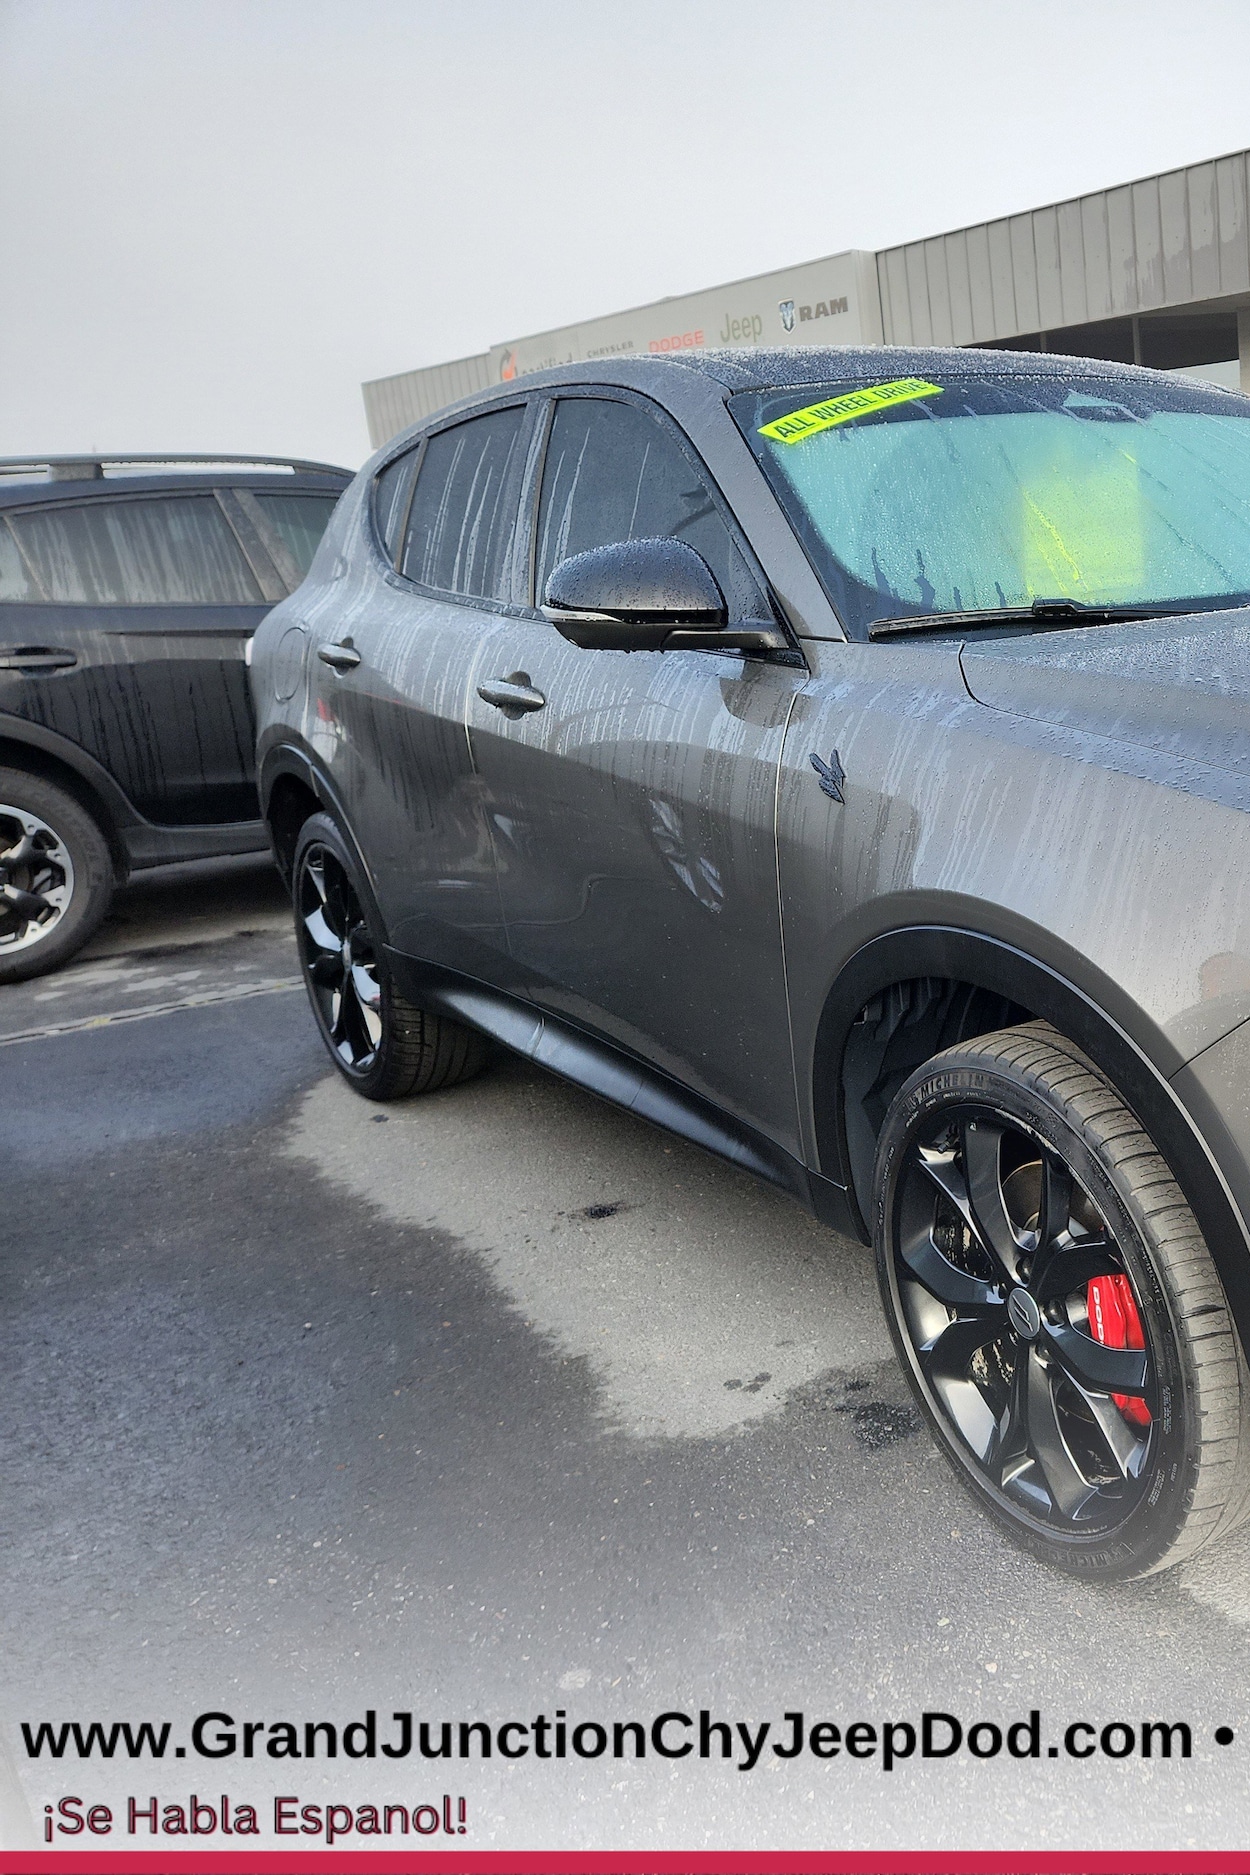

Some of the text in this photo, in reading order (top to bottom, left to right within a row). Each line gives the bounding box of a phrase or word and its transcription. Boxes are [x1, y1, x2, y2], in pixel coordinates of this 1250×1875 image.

[799, 296, 849, 323] RAM
[720, 312, 763, 343] Jeep
[587, 340, 634, 359] CHRYSLER
[649, 330, 705, 353] DODGE
[773, 381, 928, 438] ALL WHEEL DRIVE
